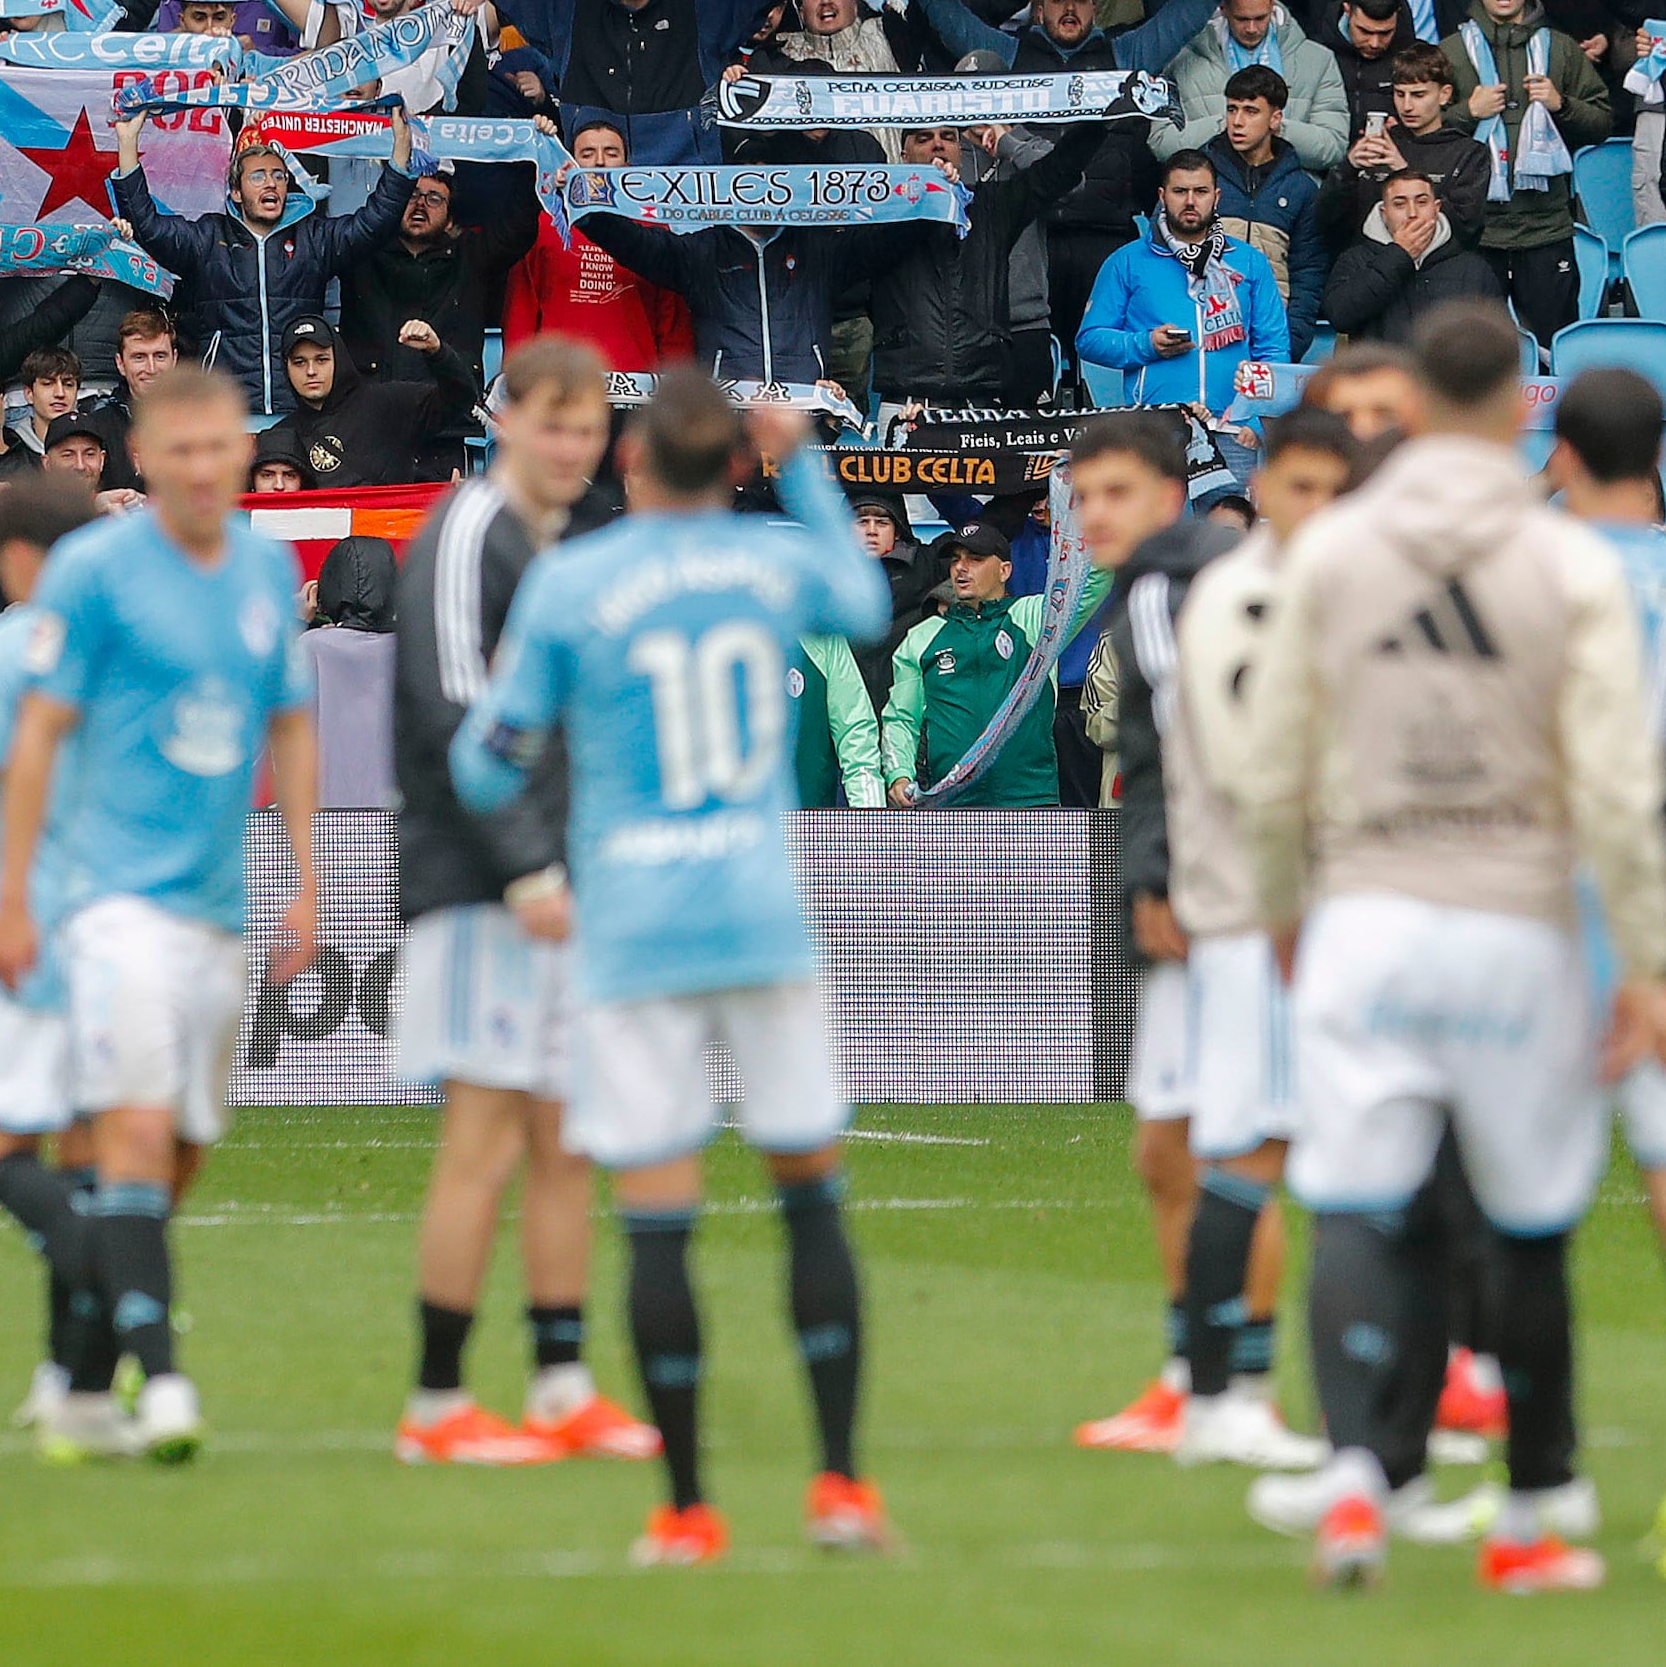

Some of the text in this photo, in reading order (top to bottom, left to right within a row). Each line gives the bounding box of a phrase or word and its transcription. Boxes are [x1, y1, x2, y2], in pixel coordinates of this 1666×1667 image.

[259, 114, 384, 137] MANCHESTER UNITED
[619, 169, 892, 207] EXILES 1873
[663, 207, 771, 222] DO CABLE CLUB
[580, 252, 614, 263] ALONE
[588, 262, 614, 272] KNOW
[580, 272, 601, 280] WHAT
[838, 454, 997, 486] CLUB CELTA
[628, 623, 785, 810] 10
